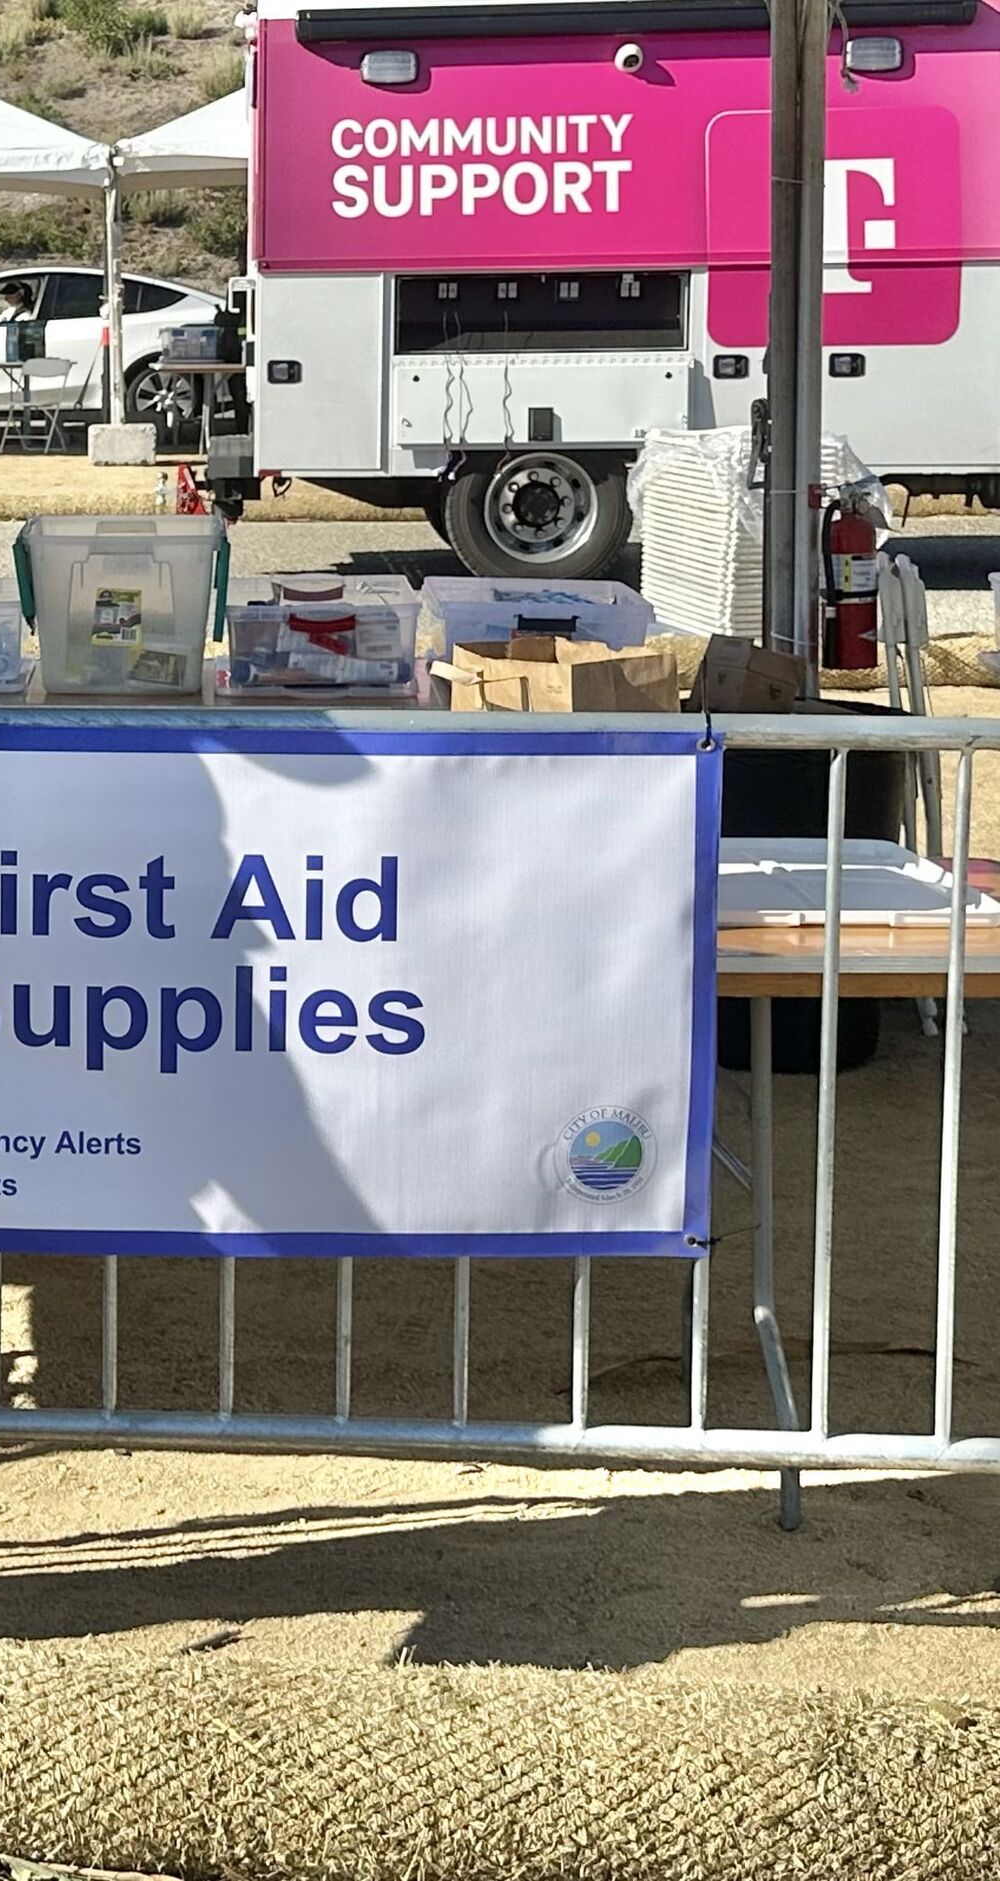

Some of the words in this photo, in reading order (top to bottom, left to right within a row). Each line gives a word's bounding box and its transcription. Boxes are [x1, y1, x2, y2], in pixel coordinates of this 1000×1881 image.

[332, 114, 632, 158] COMMUNITY
[332, 160, 632, 218] SUPPORT
[209, 854, 398, 943] Aid
[54, 1130, 142, 1156] Alerts
[562, 1114, 588, 1141] CITY
[589, 1108, 607, 1120] OF
